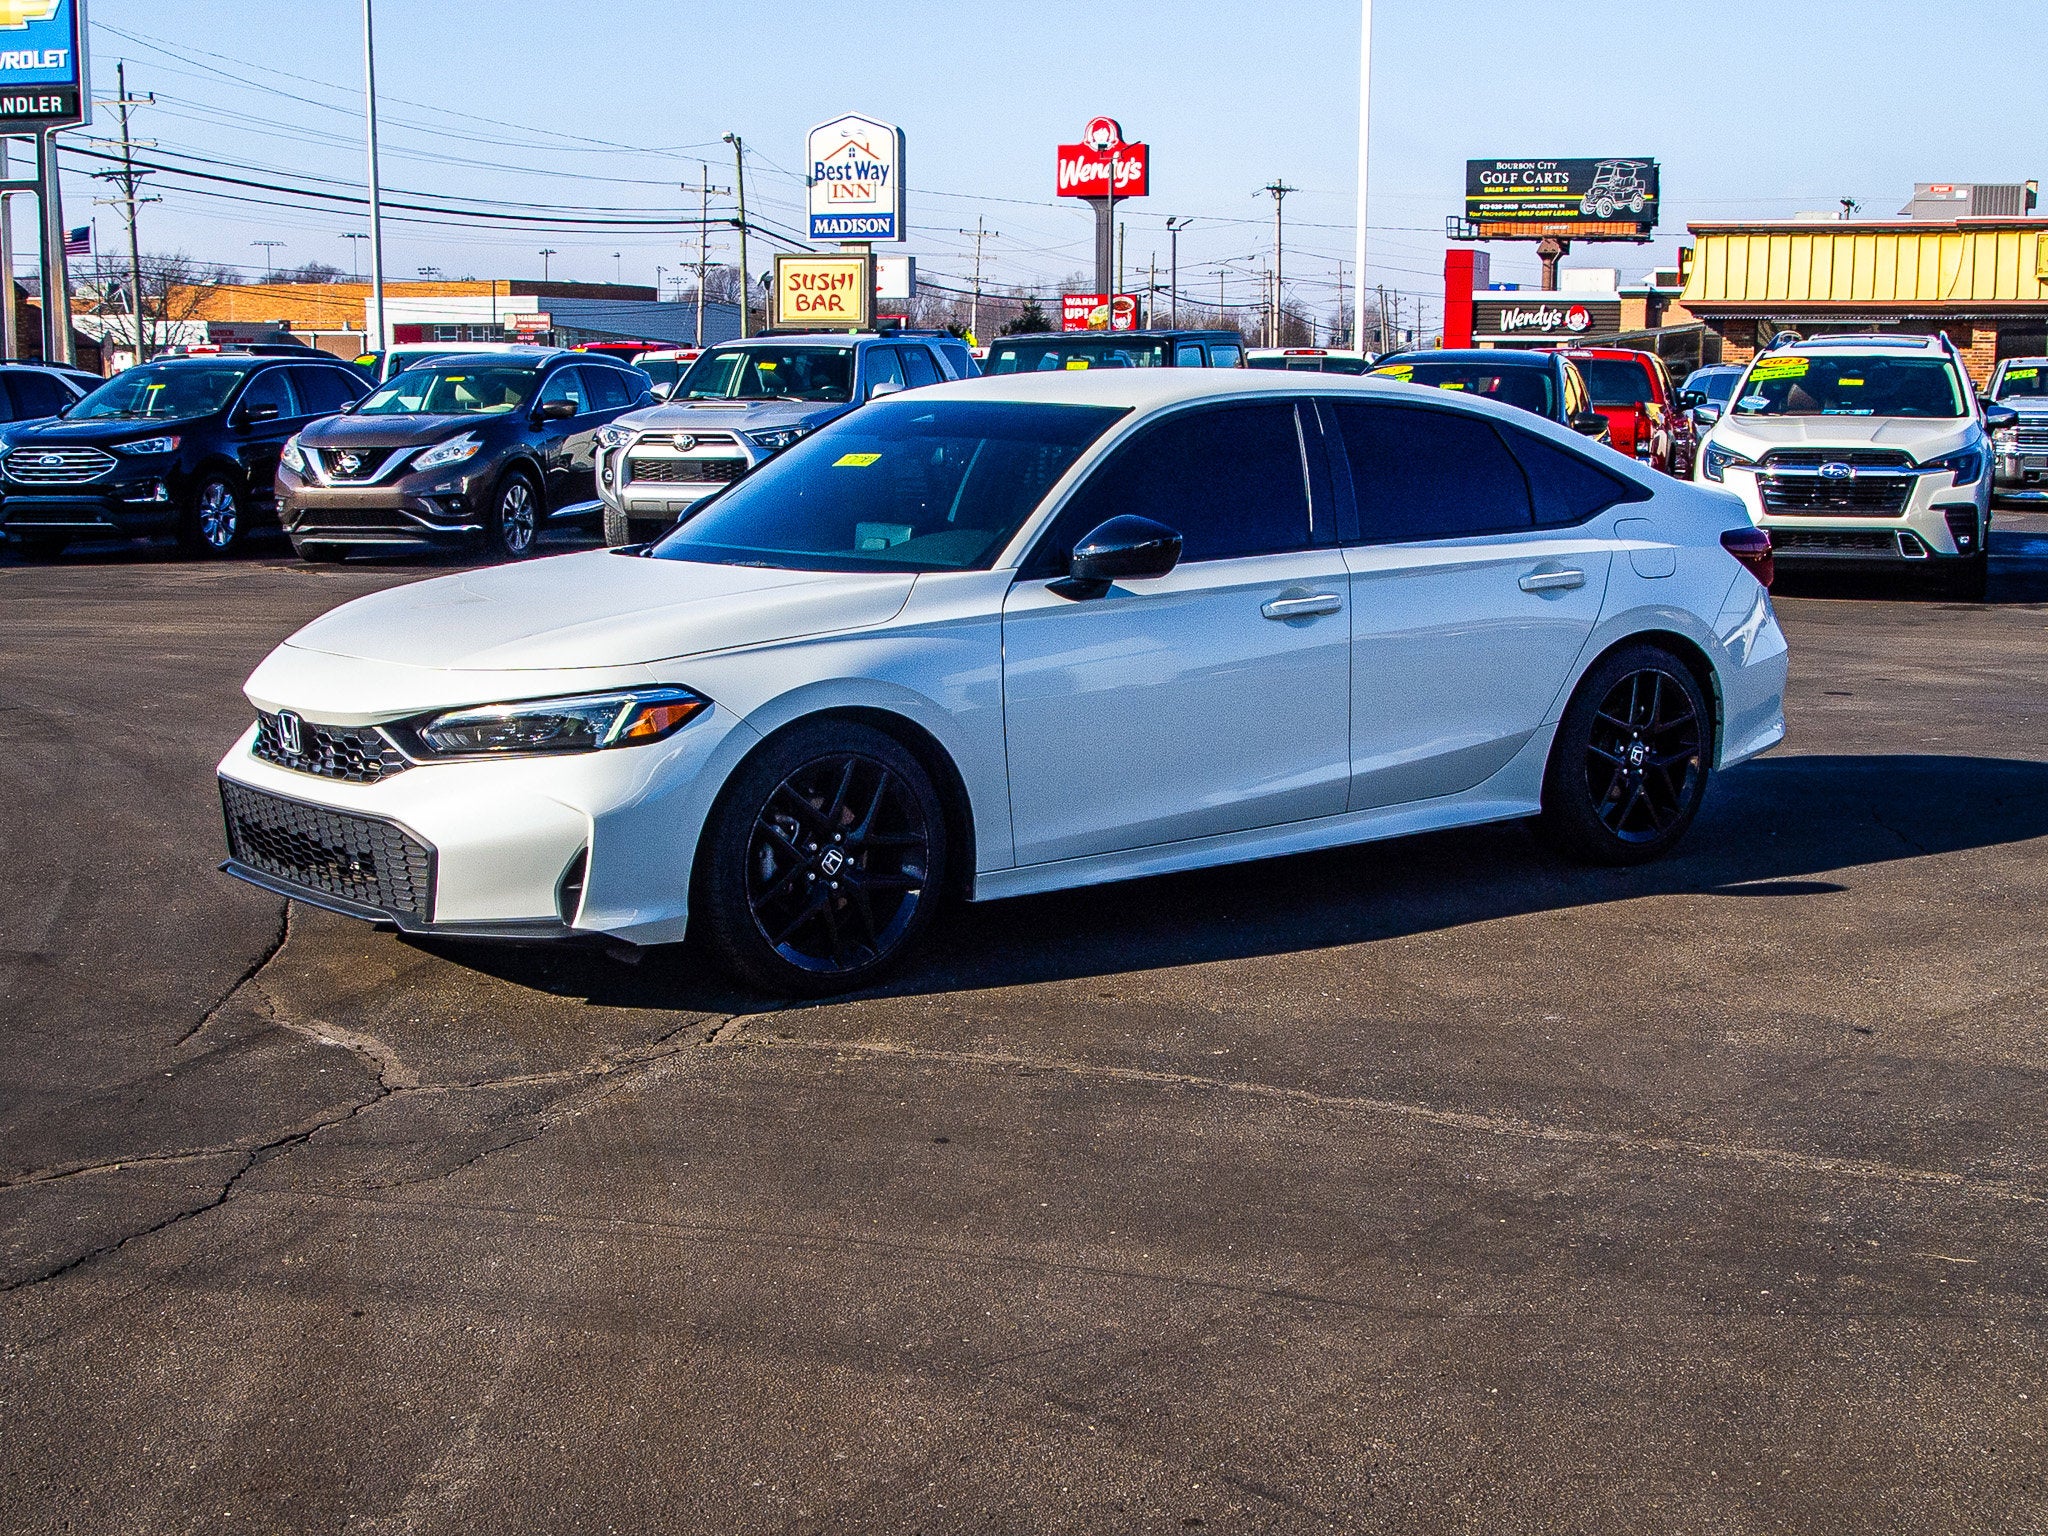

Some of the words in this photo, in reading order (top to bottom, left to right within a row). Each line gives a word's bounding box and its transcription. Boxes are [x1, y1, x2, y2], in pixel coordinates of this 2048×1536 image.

[0, 96, 63, 113] NDLER
[814, 161, 852, 181] Best
[854, 160, 890, 187] Way
[1496, 162, 1535, 170] BOURBON
[1537, 161, 1557, 170] CITY
[1480, 171, 1518, 184] GOLF
[1522, 171, 1569, 184] CARTS
[832, 183, 872, 198] INN
[813, 218, 891, 234] MADISON
[788, 273, 854, 291] SUSHI
[795, 294, 845, 311] BAR
[1064, 297, 1098, 306] WARM
[1064, 308, 1089, 320] UP!
[1501, 304, 1562, 332] Wendy's
